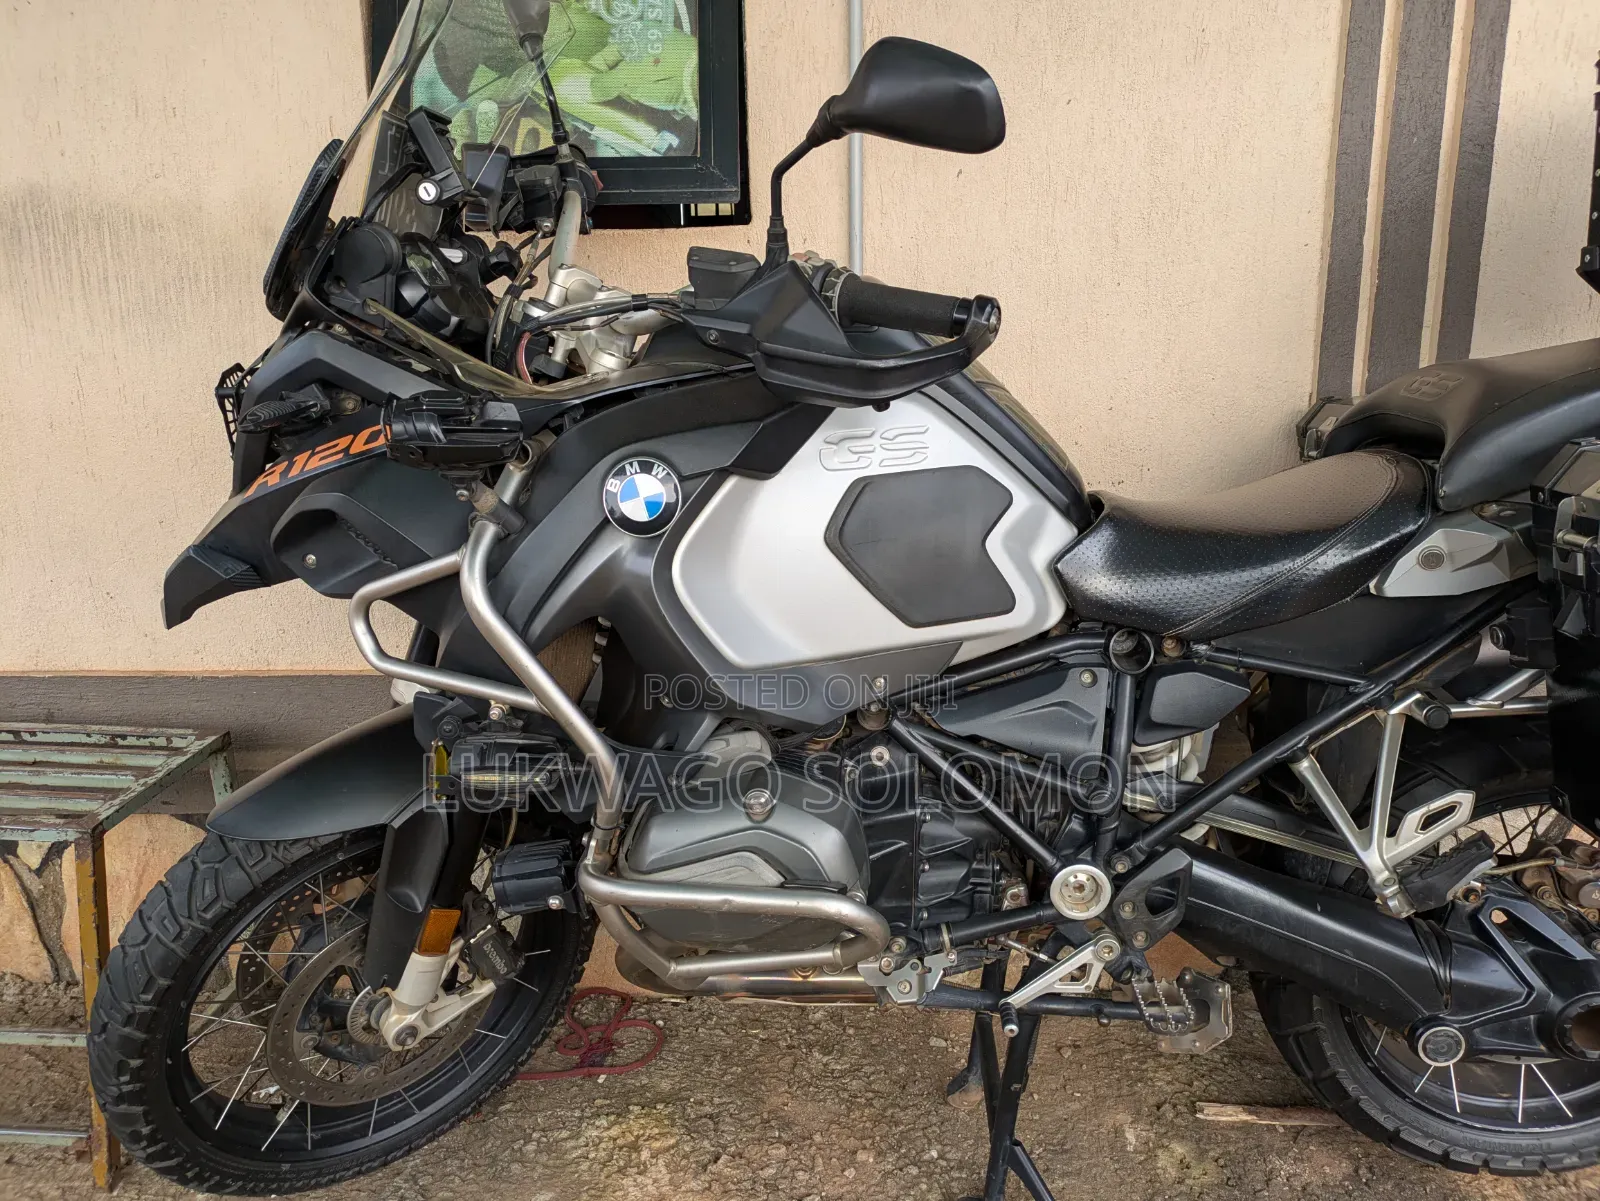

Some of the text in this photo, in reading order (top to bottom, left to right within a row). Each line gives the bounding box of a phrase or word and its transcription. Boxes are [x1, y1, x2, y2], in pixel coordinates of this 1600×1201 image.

[819, 424, 930, 472] GS
[606, 460, 668, 493] BMW
[482, 940, 508, 974] brembo
